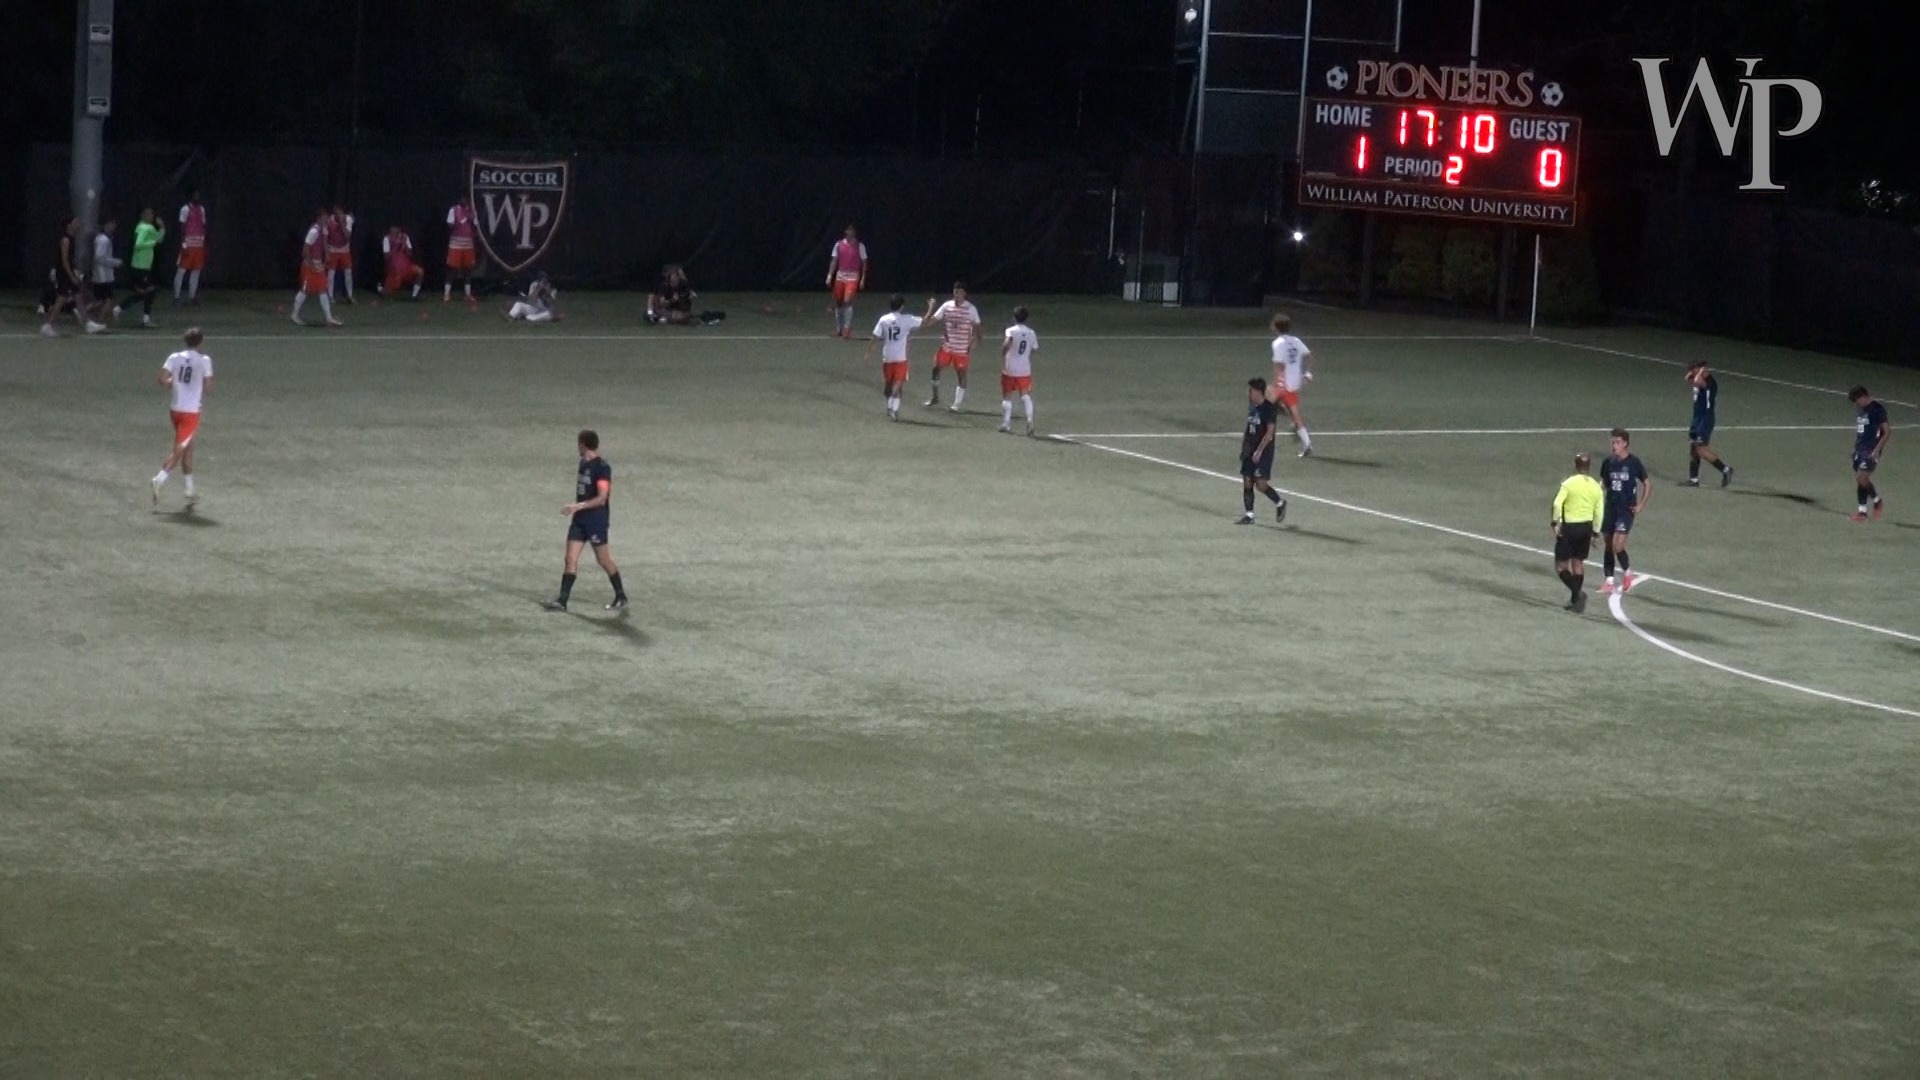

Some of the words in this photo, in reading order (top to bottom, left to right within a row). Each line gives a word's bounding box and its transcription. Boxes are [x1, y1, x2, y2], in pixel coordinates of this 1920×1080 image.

[1355, 60, 1535, 107] PIONEERS
[1316, 104, 1372, 127] HOME
[1509, 118, 1570, 142] GUEST
[1356, 136, 1367, 170] 1
[479, 170, 558, 186] SOCCER
[1384, 156, 1443, 178] PERIOD
[1446, 155, 1464, 186] 2
[1539, 148, 1562, 188] 0
[1307, 184, 1377, 203] WILLIAM
[1384, 190, 1465, 212] PATERSON
[1470, 199, 1569, 221] UNIVERSITY
[482, 192, 550, 250] WP
[888, 326, 901, 341] 12
[178, 366, 192, 383] 18
